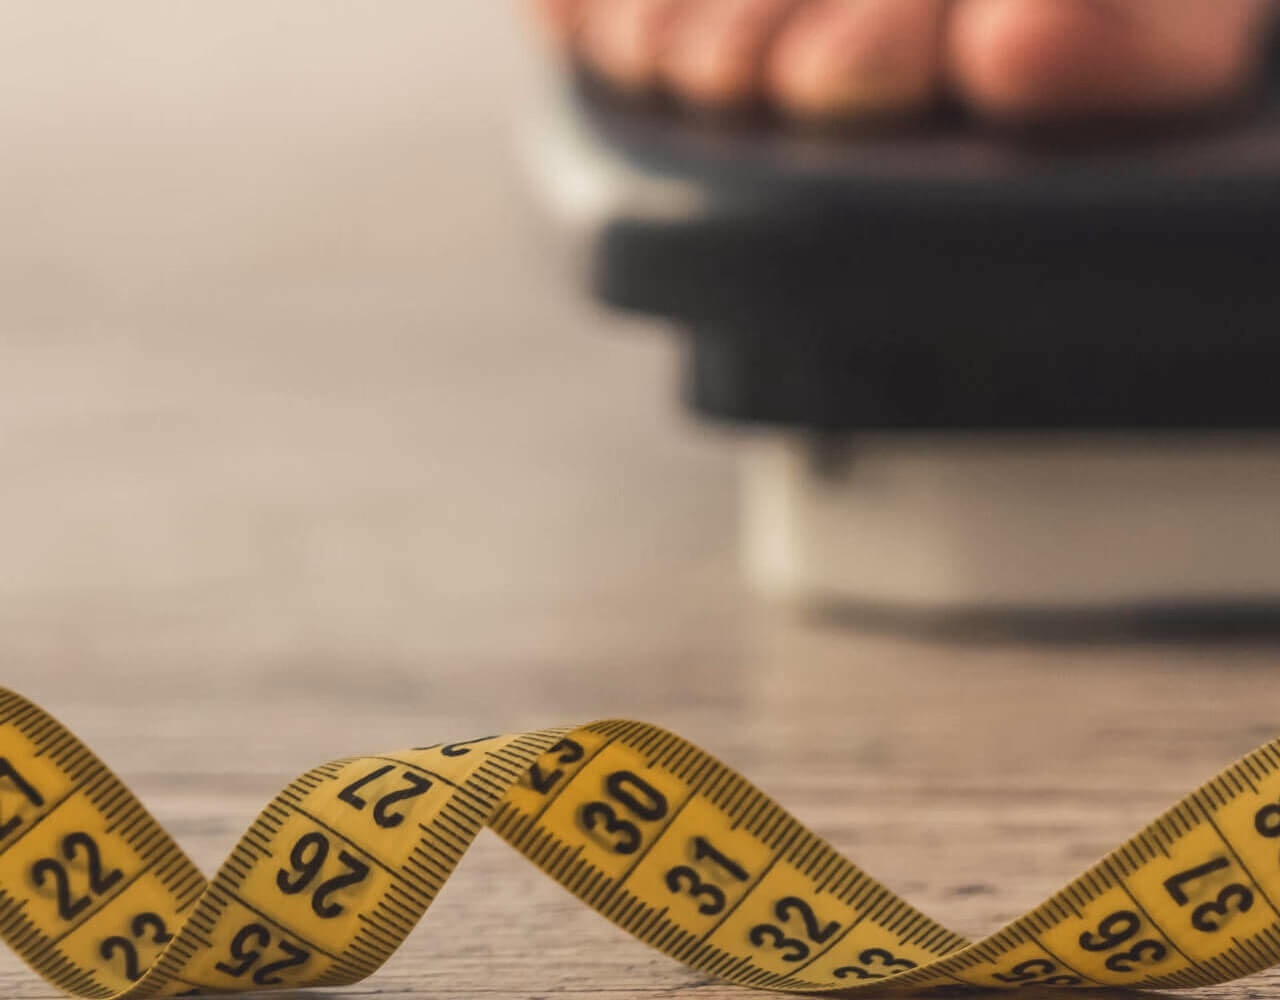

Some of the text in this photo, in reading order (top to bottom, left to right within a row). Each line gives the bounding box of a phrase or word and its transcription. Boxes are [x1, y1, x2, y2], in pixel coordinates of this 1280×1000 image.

[0, 757, 44, 841] 1
[338, 765, 432, 828] 27
[581, 771, 667, 855] 30
[32, 832, 123, 921] 22
[276, 832, 370, 919] 26
[666, 837, 749, 915] 31
[1164, 857, 1253, 932] 37
[215, 923, 311, 987] 25
[749, 897, 840, 962] 32
[1079, 911, 1168, 973] 36
